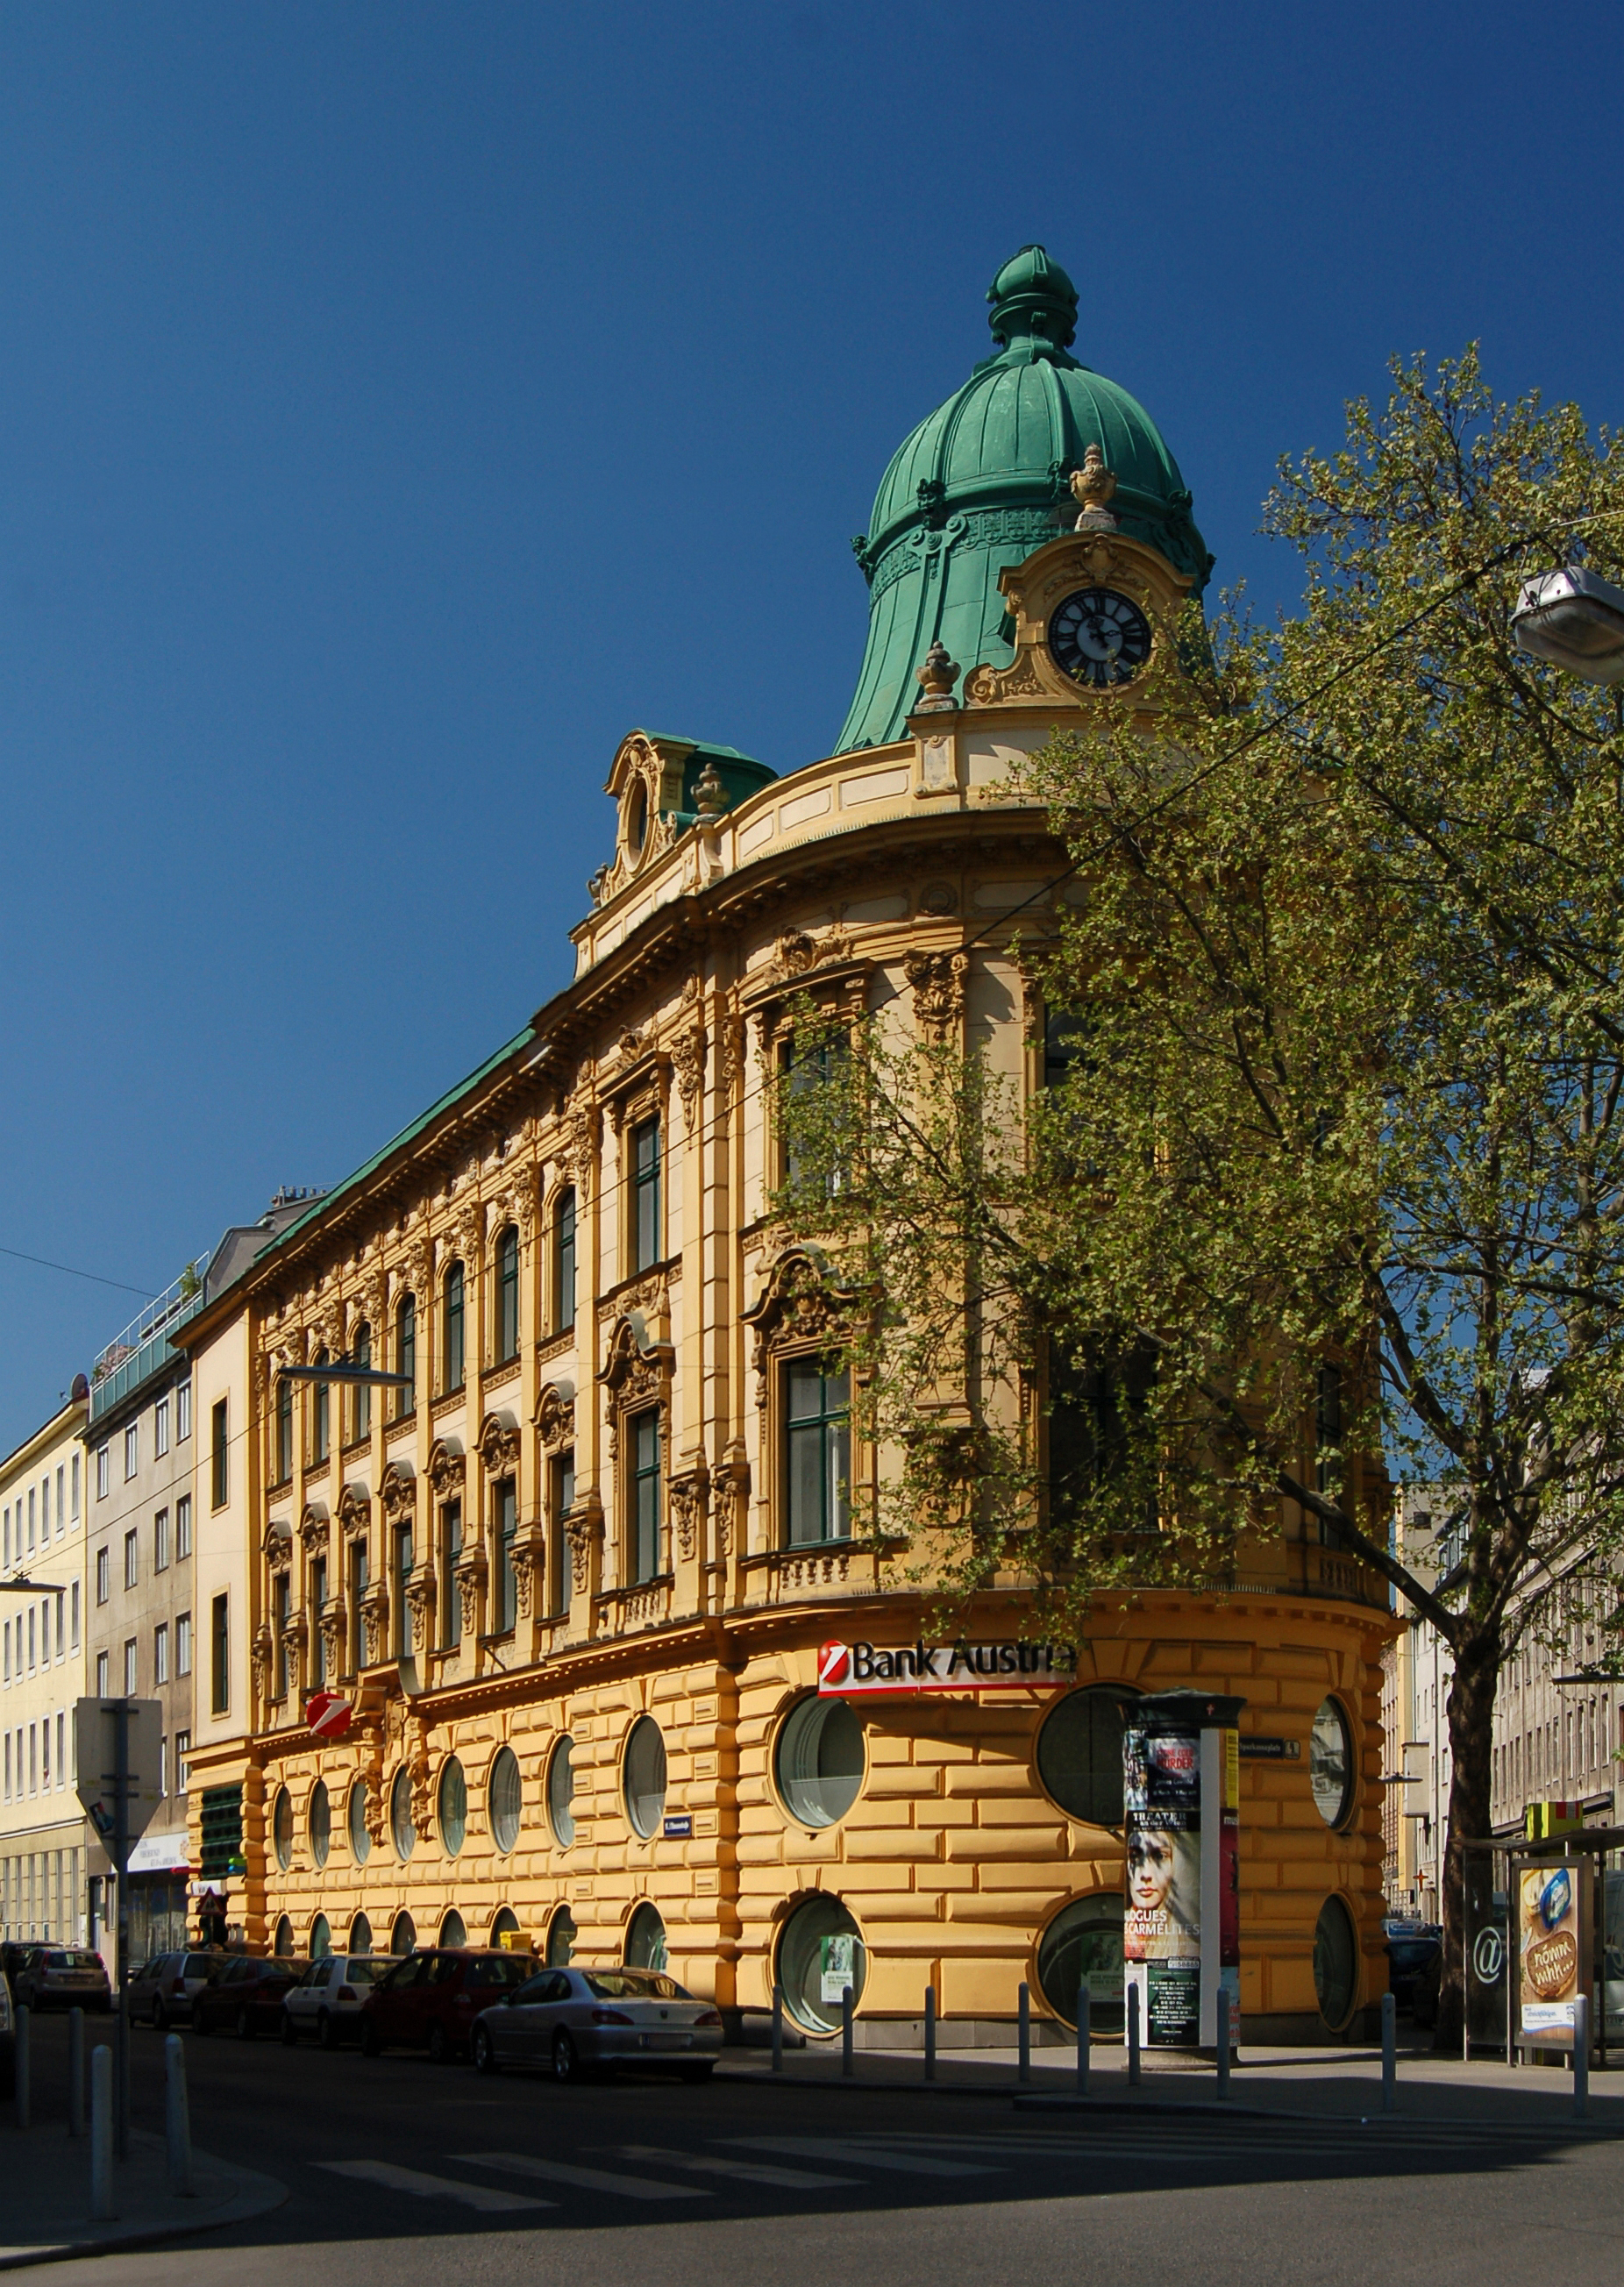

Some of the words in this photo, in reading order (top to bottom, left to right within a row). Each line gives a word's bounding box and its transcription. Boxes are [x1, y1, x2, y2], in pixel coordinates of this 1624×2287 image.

[852, 1640, 937, 1679] Bank
[946, 1639, 1077, 1676] Austria
[1156, 1756, 1193, 1770] MURDER
[1133, 1812, 1186, 1821] THEATER
